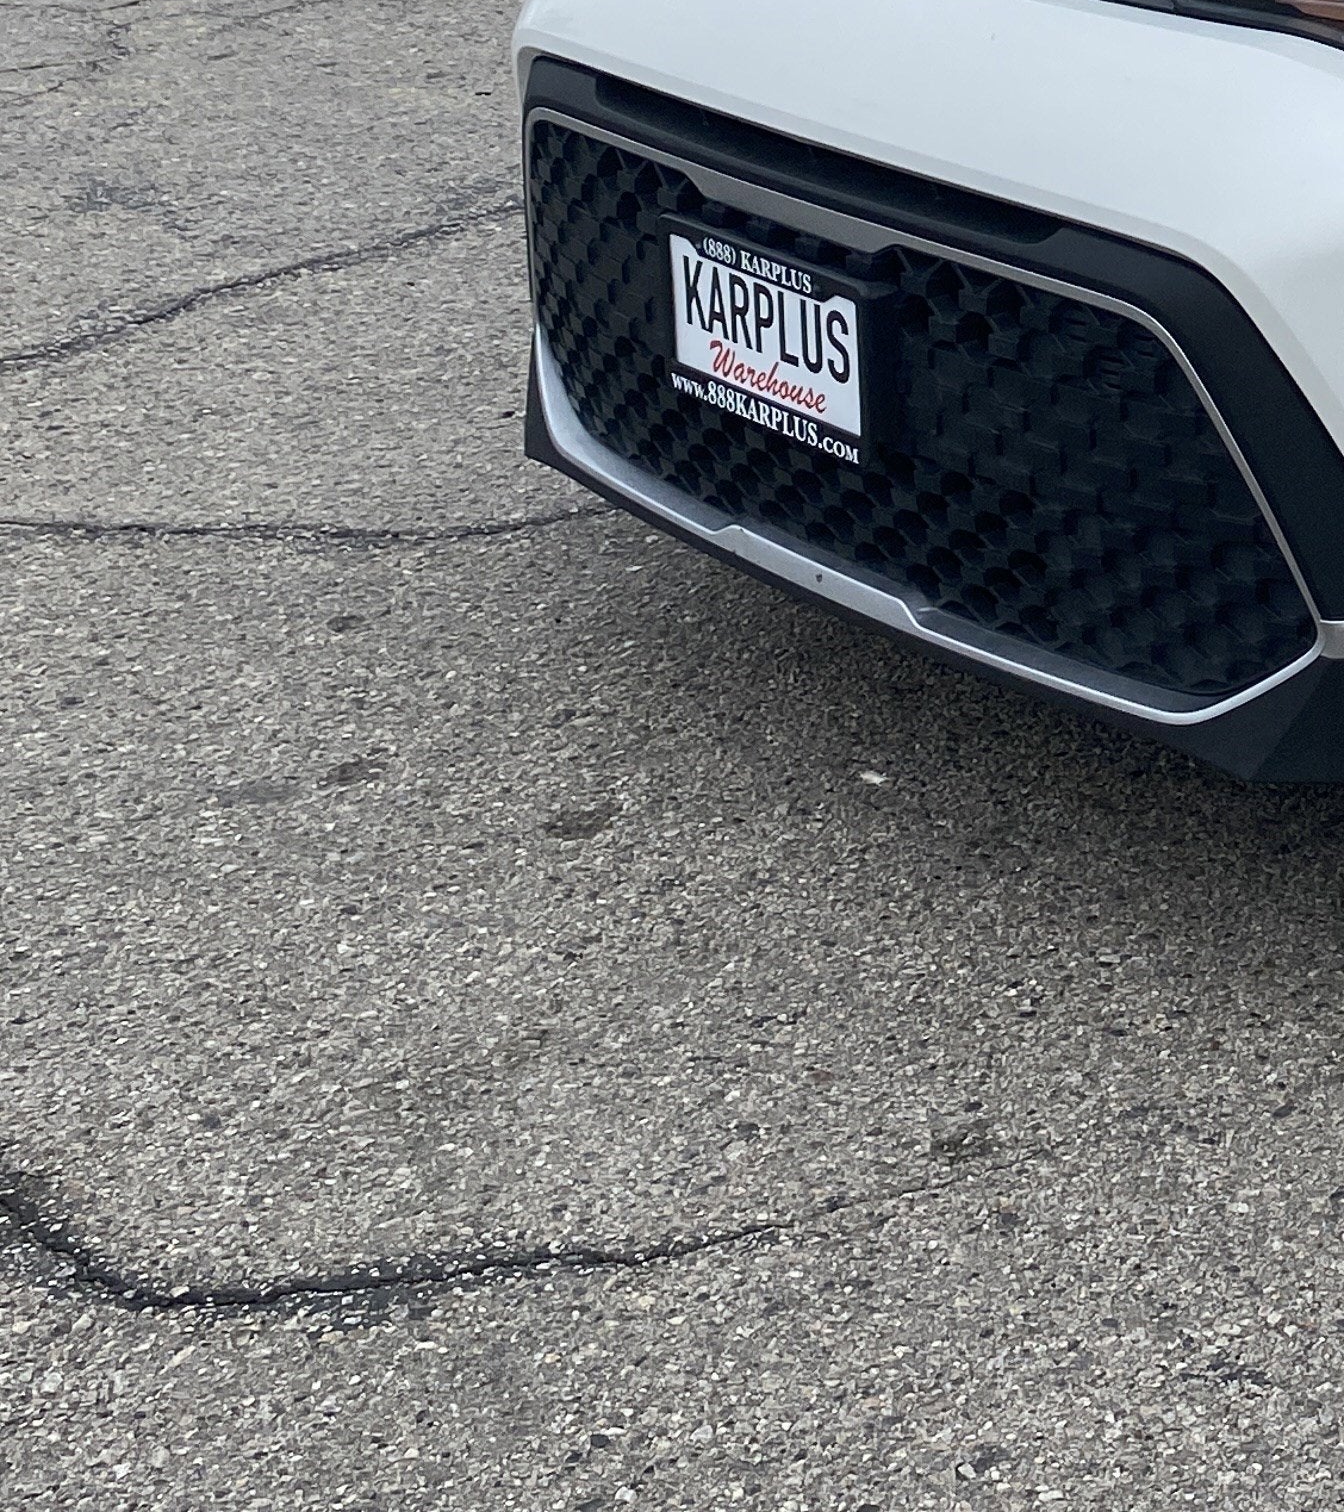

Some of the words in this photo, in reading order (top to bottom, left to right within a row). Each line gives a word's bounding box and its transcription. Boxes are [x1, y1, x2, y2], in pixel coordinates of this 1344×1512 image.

[702, 237, 736, 266] (888)
[740, 249, 812, 294] KARPLUS
[682, 254, 851, 384] KARPLUS
[709, 340, 828, 414] Warehouse
